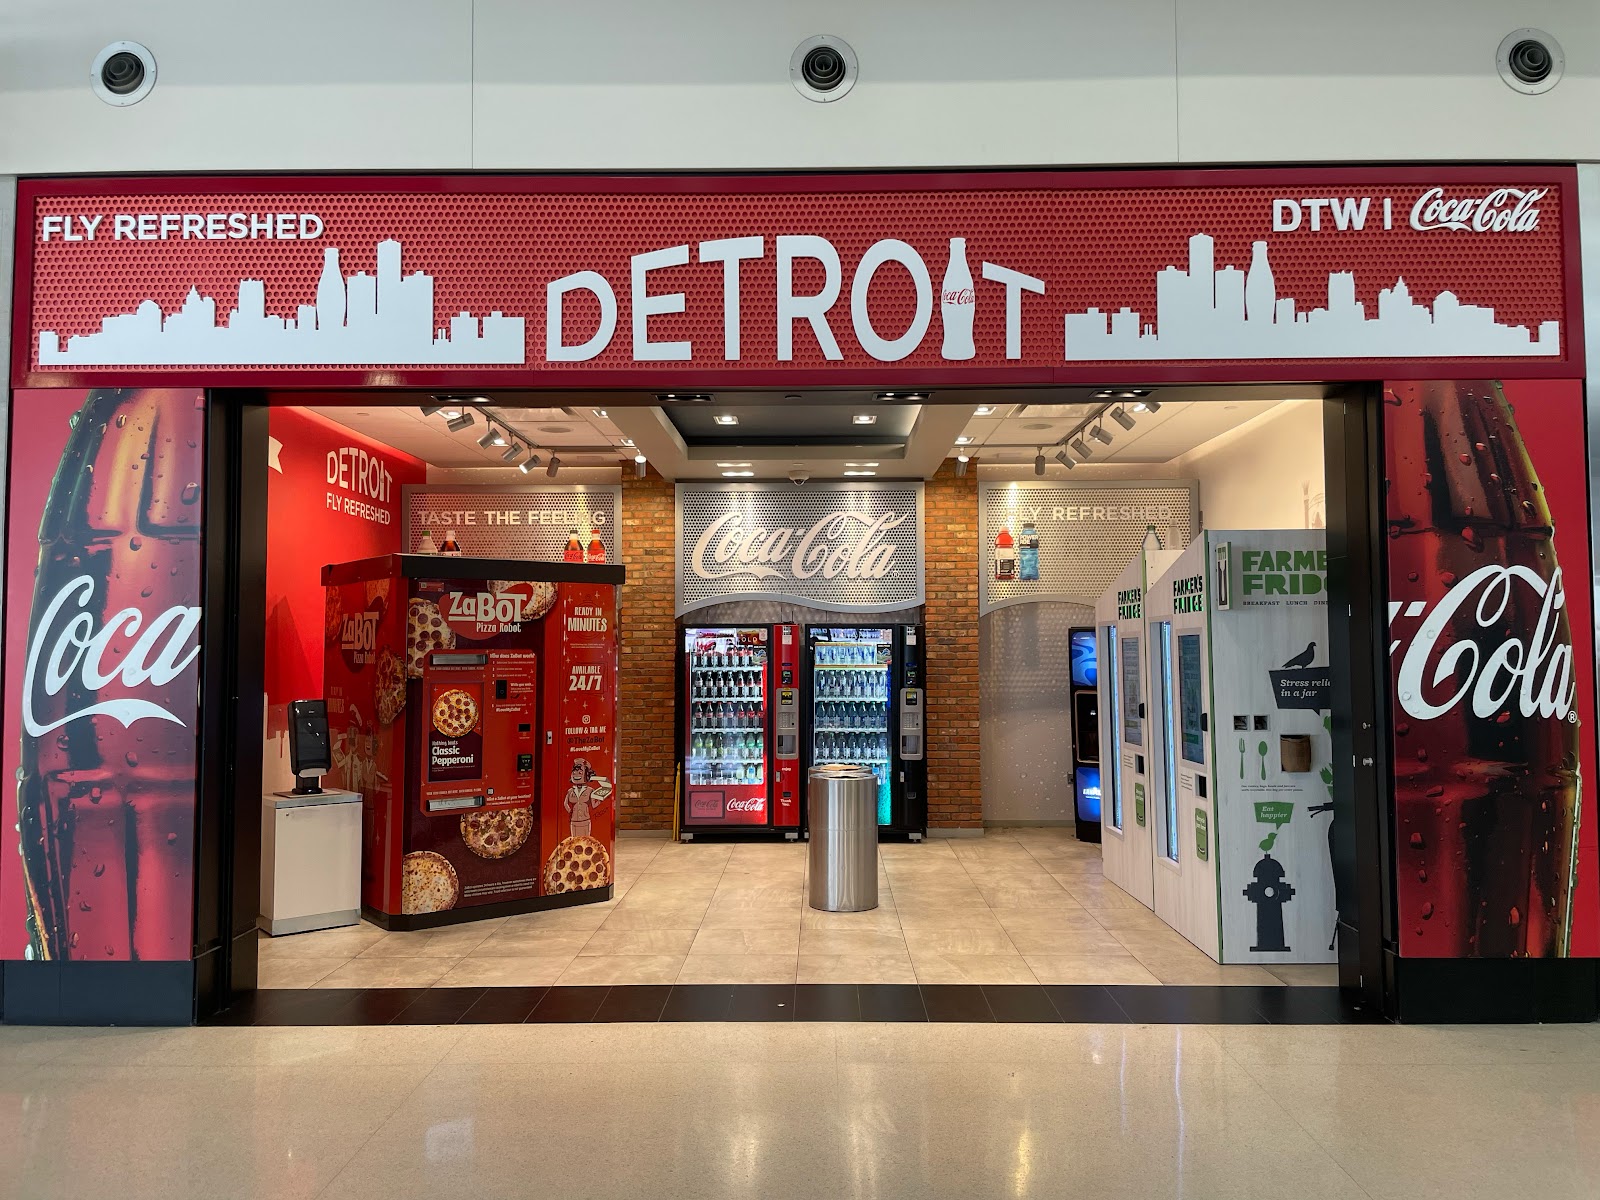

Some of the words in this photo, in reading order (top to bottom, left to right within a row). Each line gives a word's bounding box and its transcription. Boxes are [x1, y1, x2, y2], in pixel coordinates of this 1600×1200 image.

[1272, 198, 1371, 232] DTW
[1410, 187, 1548, 232] Coca-Cola
[42, 216, 102, 241] FLY
[114, 213, 324, 240] REFRESHED
[546, 235, 1045, 362] DETROIT
[327, 446, 392, 503] DETROIT
[326, 492, 342, 512] FLY
[344, 498, 391, 525] REFRESHED
[1005, 506, 1042, 521] FLY
[1052, 506, 1171, 521] REFRESHED
[418, 511, 477, 525] TASTE
[484, 511, 521, 525] THE
[528, 511, 606, 525] FEELING
[692, 511, 909, 581] Coca-Cola
[1243, 574, 1328, 595] FRID
[574, 606, 594, 616] READY
[595, 607, 603, 617] IN
[476, 622, 497, 633] Pizza
[499, 622, 522, 633] Robot
[567, 617, 608, 632] MINUTES
[22, 574, 203, 737] Coca
[571, 665, 601, 675] AVAILABLE
[569, 675, 603, 691] 24/7
[1280, 679, 1310, 687] Stress
[1280, 688, 1291, 697] in
[1300, 688, 1318, 699] jar
[565, 727, 583, 735] FOLLOW
[431, 745, 461, 755] Classic
[431, 754, 475, 767] Pepperoni
[726, 798, 766, 812] Coca-Cola
[1260, 812, 1288, 820] happier
